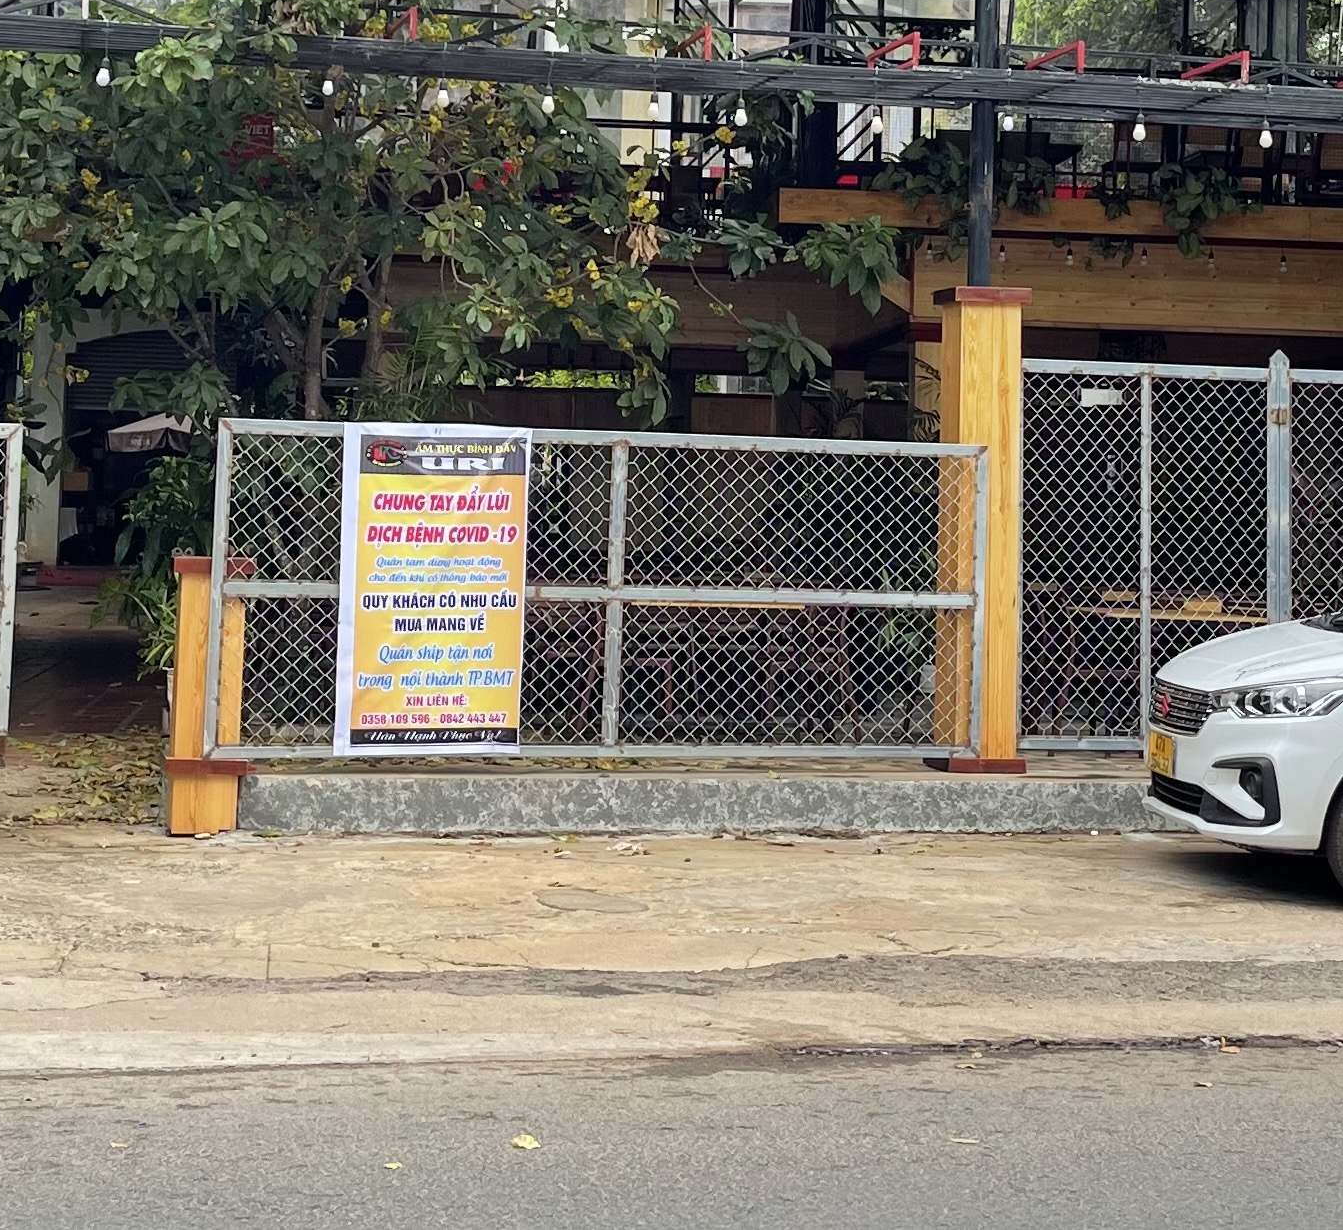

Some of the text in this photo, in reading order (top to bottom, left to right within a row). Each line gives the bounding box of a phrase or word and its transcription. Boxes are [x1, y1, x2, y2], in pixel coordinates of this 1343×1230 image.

[421, 456, 506, 471] URI
[373, 485, 511, 512] CHUNG TAY ĐẨY LÙI
[367, 525, 404, 548] DỊCH
[406, 522, 446, 548] BỆNH
[448, 526, 490, 543] COVID
[392, 591, 436, 609] KHÁCH
[439, 591, 457, 608] CÓ
[460, 594, 488, 608] NHU
[394, 618, 423, 632] MUA
[426, 617, 466, 632] MANG
[379, 645, 413, 664] Quán
[417, 644, 446, 664] ship
[447, 645, 471, 663] tận
[358, 670, 515, 690] trong nội thành TP.BMT
[405, 695, 424, 707] XIN
[426, 694, 449, 707] LIÊN
